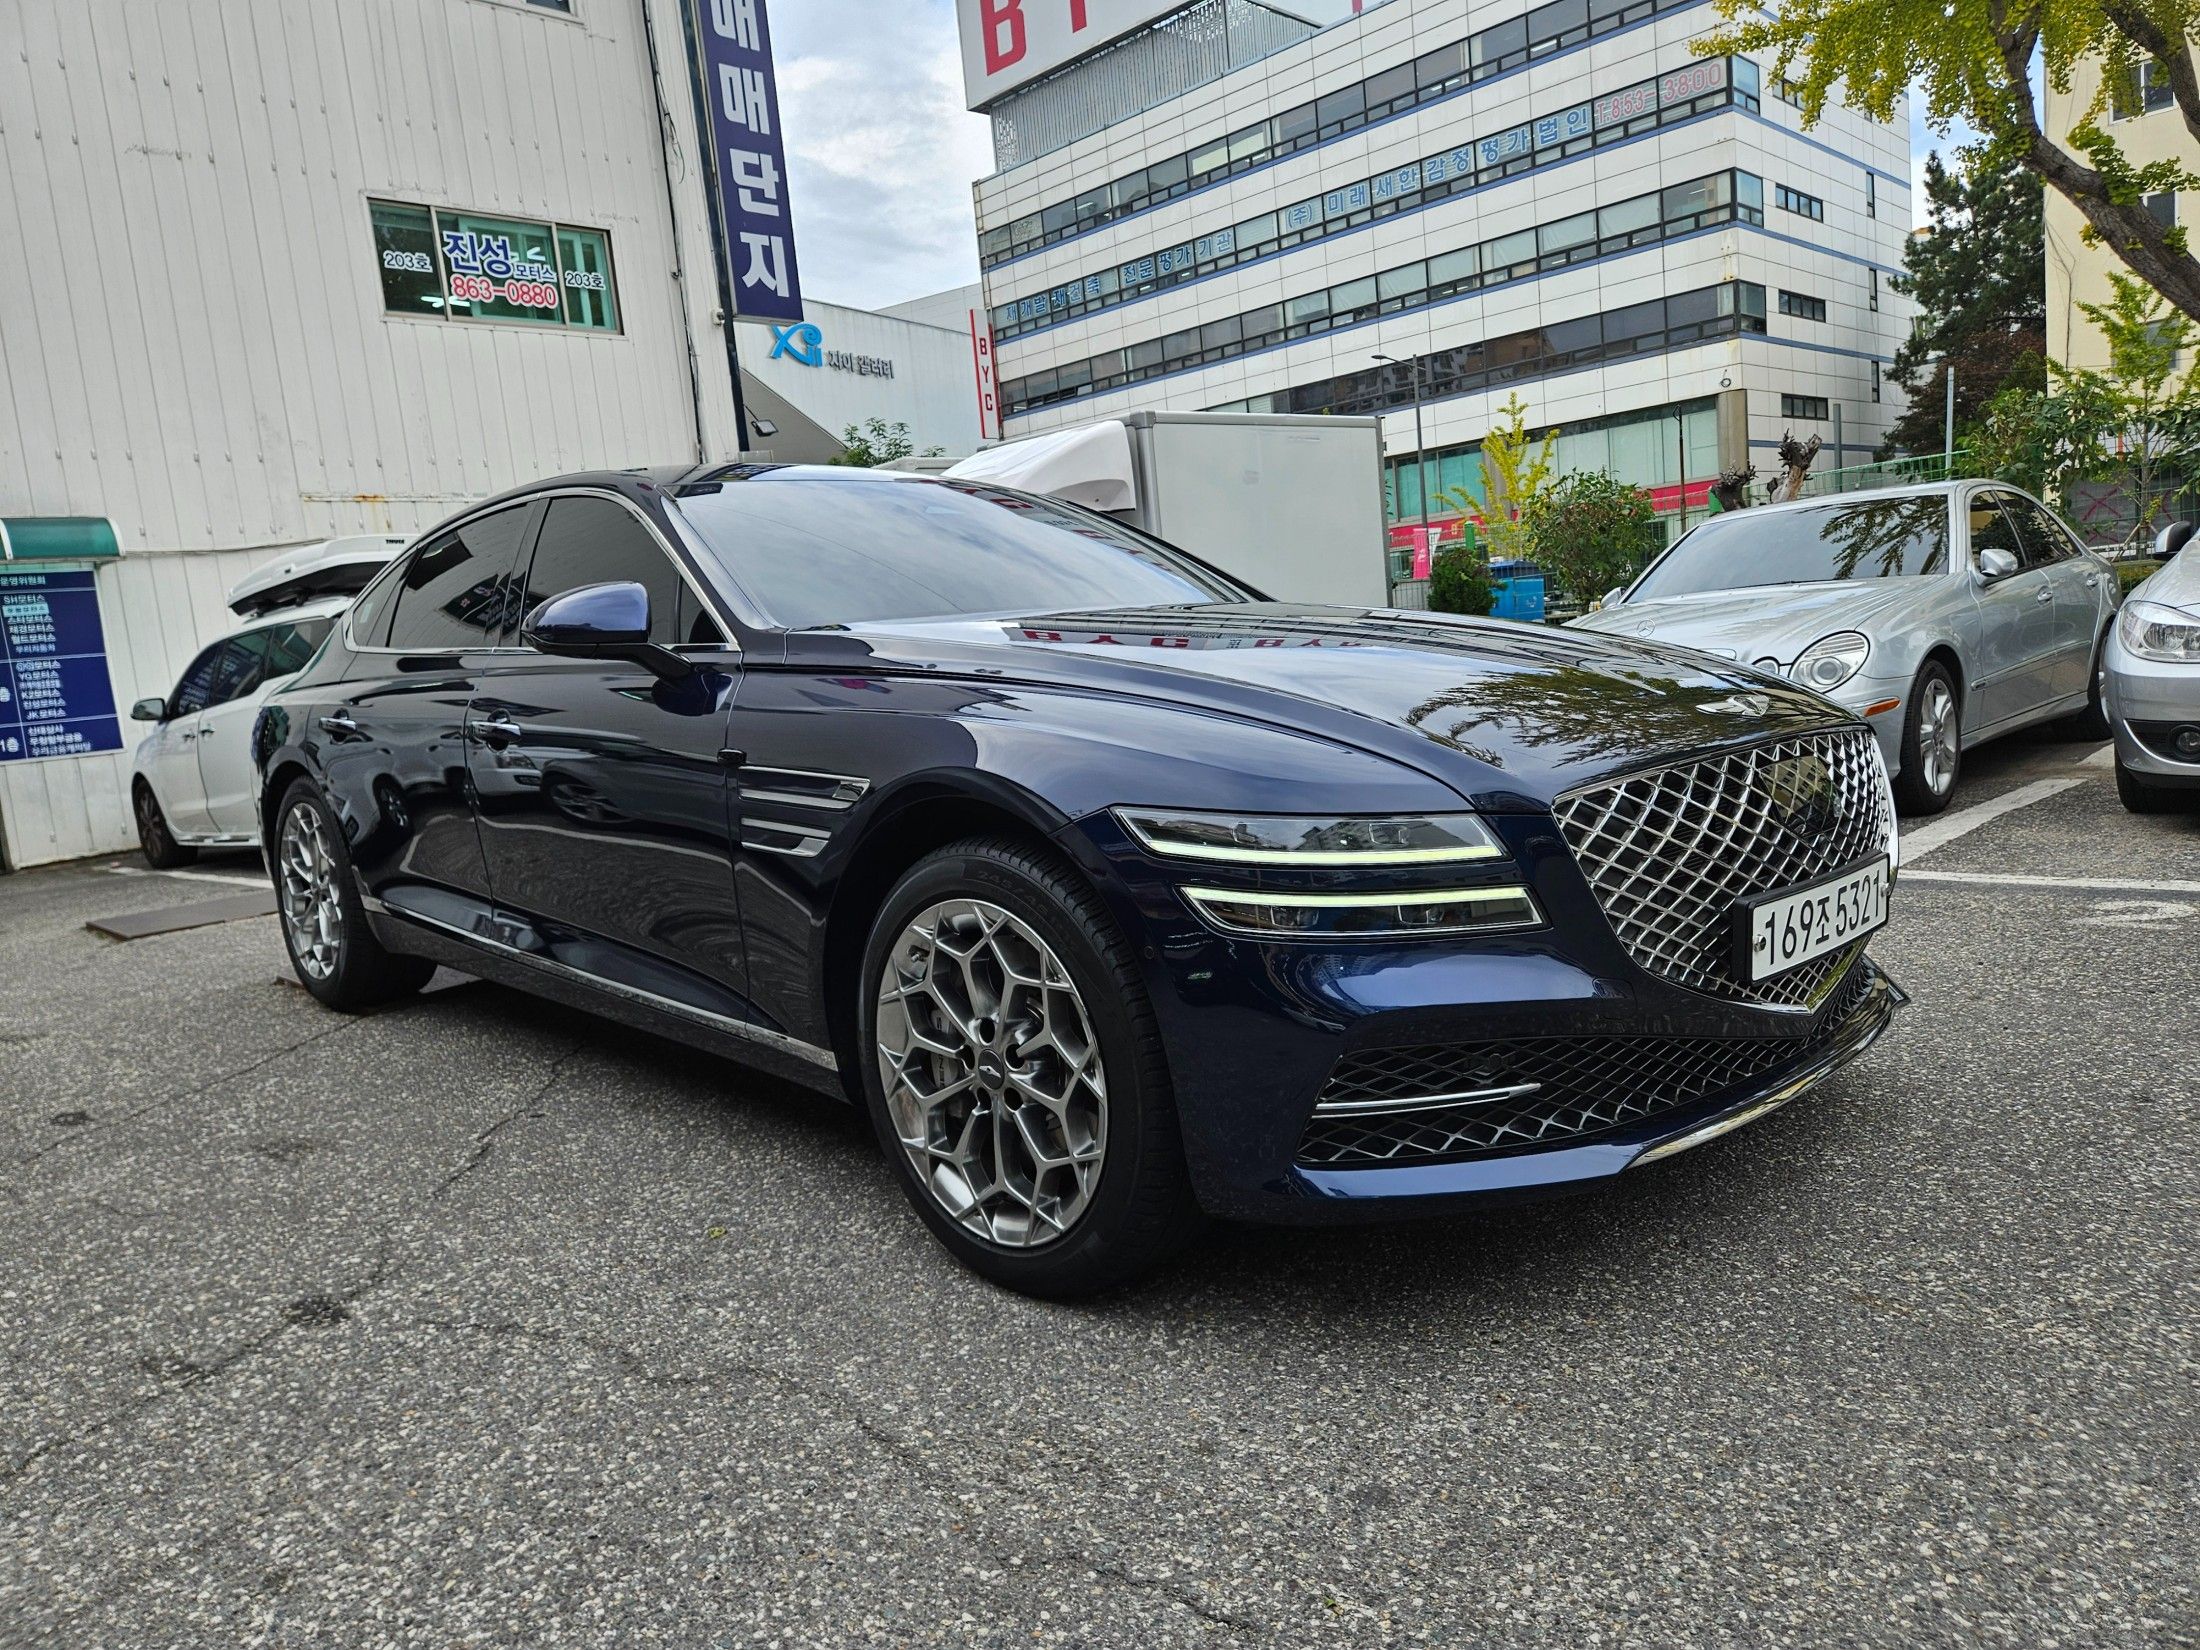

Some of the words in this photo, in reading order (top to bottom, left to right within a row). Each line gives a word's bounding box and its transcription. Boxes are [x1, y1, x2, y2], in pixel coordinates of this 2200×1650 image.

[711, 0, 789, 297] 매매단지
[1287, 204, 1313, 229] (주)
[1327, 107, 1589, 213] 미래새한감정평가법인
[383, 252, 433, 273] 203호
[443, 230, 513, 278] 진성
[514, 263, 557, 282] 모터스
[564, 271, 605, 289] 203호
[451, 275, 557, 308] 863-0880
[828, 350, 854, 373] 자이
[979, 338, 994, 411] BYC
[1765, 896, 1830, 966] 169조
[1836, 869, 1880, 937] 5321
